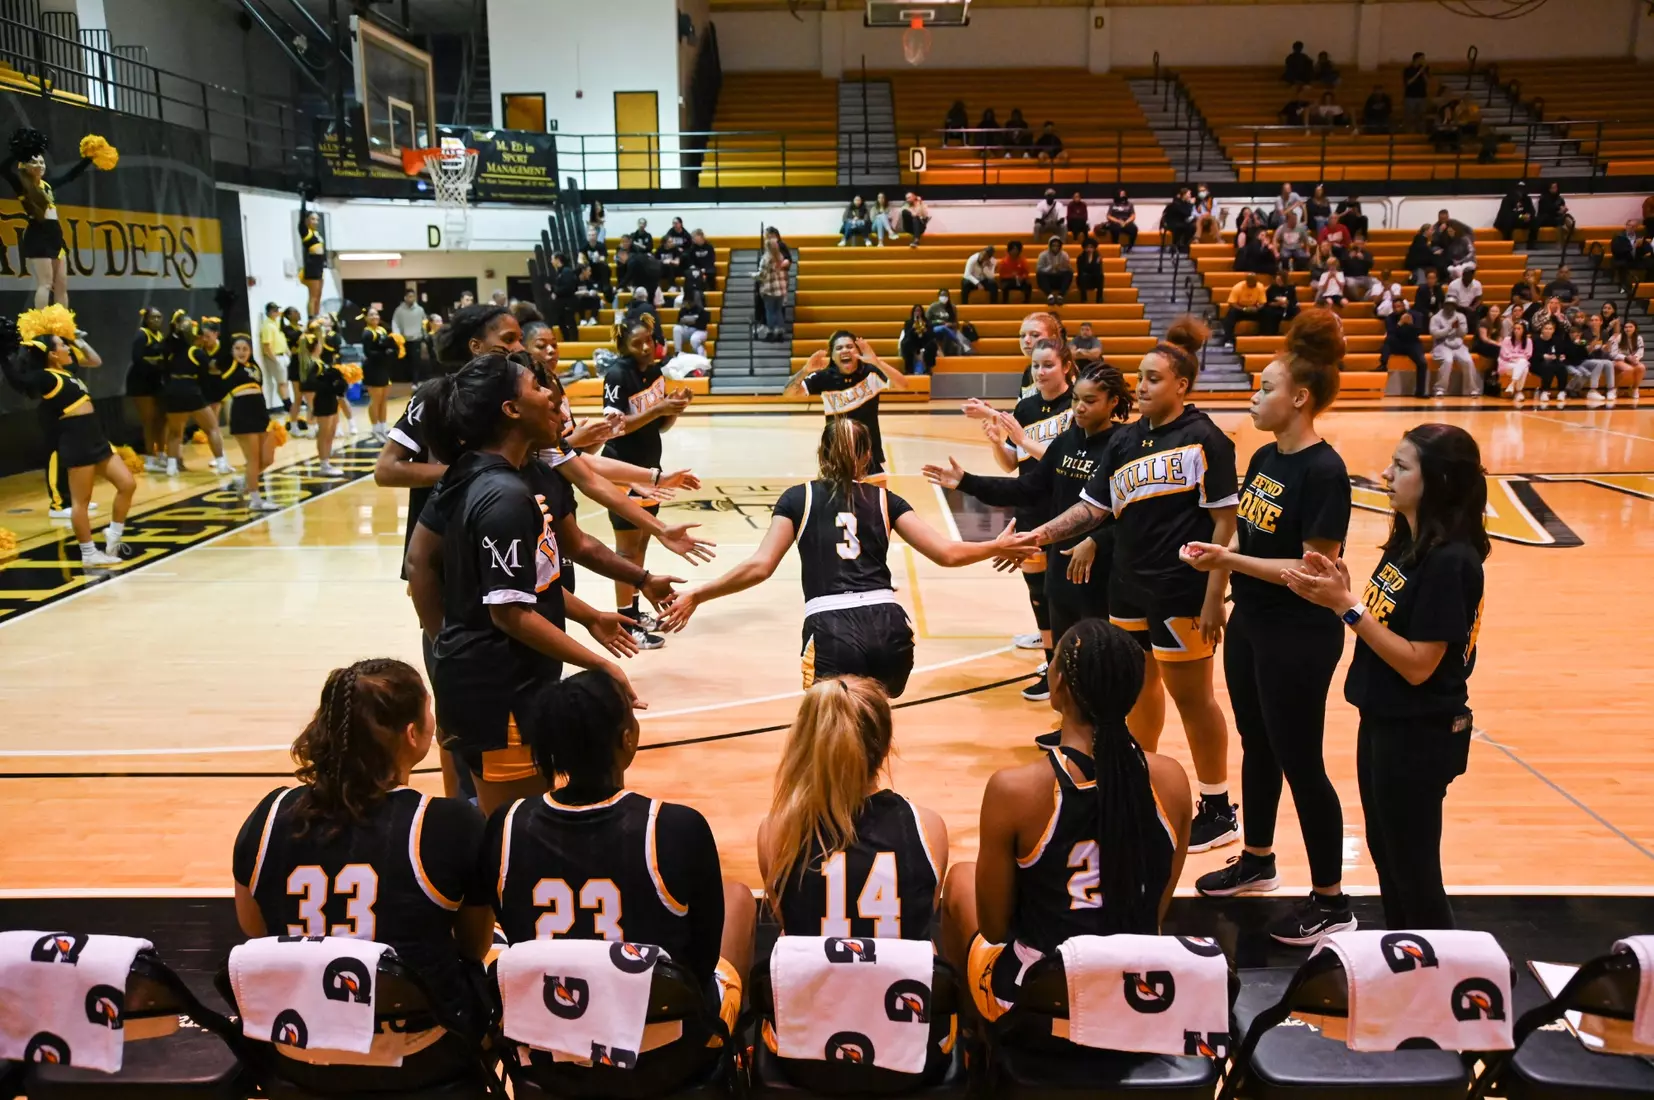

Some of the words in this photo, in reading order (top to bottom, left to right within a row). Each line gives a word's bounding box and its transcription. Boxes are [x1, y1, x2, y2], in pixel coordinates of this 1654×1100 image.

[486, 162, 547, 176] MANAGEMENT
[502, 152, 528, 164] SPORT
[912, 149, 924, 170] D
[0, 212, 199, 289] UDERS
[427, 224, 441, 248] D
[1025, 413, 1069, 443] ILLE
[1061, 454, 1094, 474] VILLE
[1113, 452, 1187, 500] VILLE
[1236, 490, 1283, 533] OUSE
[482, 536, 524, 577] M
[835, 511, 861, 559] 3
[820, 851, 901, 938] 14
[1066, 839, 1103, 910] 2
[286, 863, 379, 941] 33
[532, 878, 624, 941] 23
[1381, 932, 1438, 974] G
[323, 956, 372, 1006] G
[543, 973, 589, 1020] G
[884, 979, 931, 1023] G
[1123, 970, 1175, 1014] G
[1451, 977, 1506, 1022] G
[85, 984, 125, 1030] G
